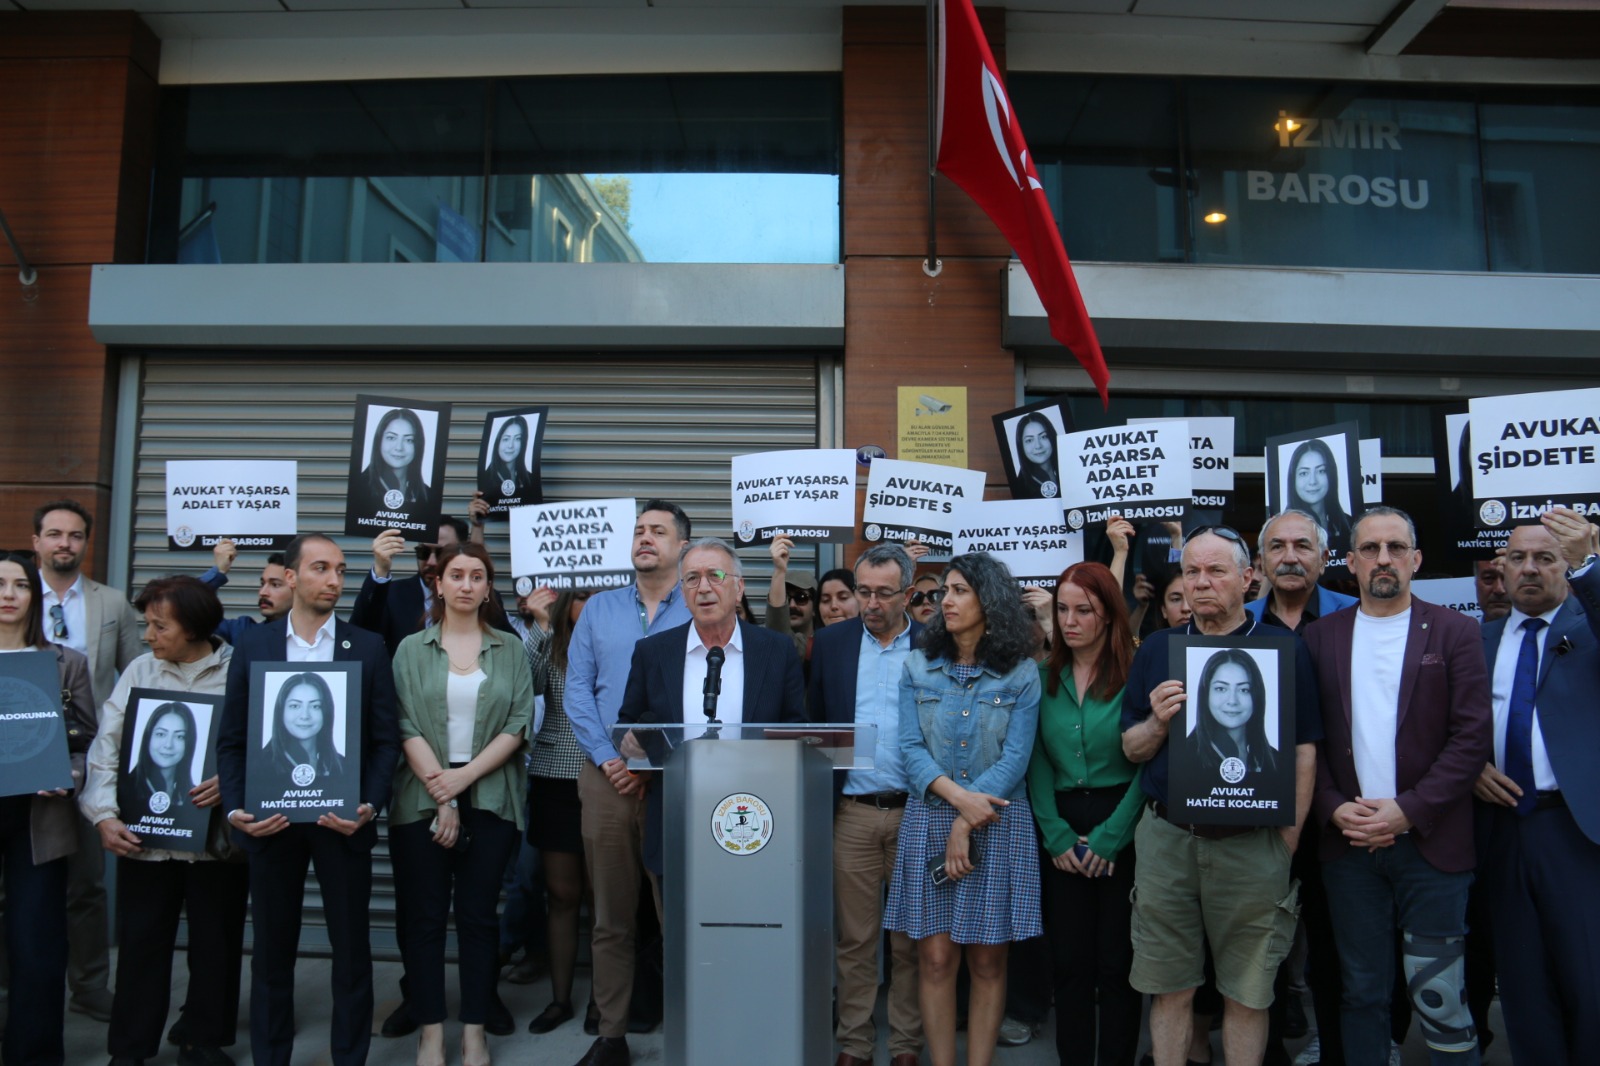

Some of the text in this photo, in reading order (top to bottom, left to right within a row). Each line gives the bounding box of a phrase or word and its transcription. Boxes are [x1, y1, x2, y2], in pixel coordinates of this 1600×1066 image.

[1278, 110, 1402, 150] İZMİR
[1247, 170, 1429, 210] BAROSU
[1500, 416, 1600, 441] AVUKA
[1083, 430, 1158, 450] AVUKAT
[1079, 447, 1166, 468] YAŞARSA
[1192, 457, 1229, 470] SON
[1477, 446, 1595, 475] ŞİDDETE
[1086, 465, 1159, 484] ADALET
[736, 475, 849, 491] AVUKAT YAŞARSA
[885, 477, 964, 498] AVUKATA
[172, 485, 290, 497] AVUKAT YAŞARSA
[744, 489, 839, 504] ADALET YAŞAR
[1091, 482, 1154, 501] YAŞAR
[182, 500, 281, 511] ADALET YAŞAR
[498, 497, 521, 505] AVUKAT
[869, 490, 938, 512] ŞİDDETE
[1191, 496, 1226, 507] ROSU
[375, 510, 410, 520] AVUKAT
[537, 506, 608, 522] AVUKAT
[1124, 505, 1184, 519] BAROSU
[357, 517, 427, 531] HATİCE KOCAEFE
[531, 522, 614, 539] YAŞARSA
[786, 529, 830, 538] BAROSU
[958, 527, 1010, 539] AVUKAT
[1477, 530, 1513, 539] AVUKA
[232, 537, 273, 546] BAROSU
[538, 538, 608, 553] ADALET
[918, 533, 953, 548] BARO
[968, 539, 1068, 552] ADALET YAŞAR
[1457, 538, 1492, 548] HATİCE
[543, 554, 603, 570] YAŞAR
[535, 574, 631, 589] İZMİR BAROSU
[283, 789, 323, 798] AVUKAT
[1211, 787, 1255, 796] AVUKAT
[261, 798, 344, 808] HATİCE KOCAEFE
[735, 796, 767, 816] BAROSU
[1186, 797, 1278, 809] HATİCE KOCAEFE
[140, 815, 175, 826] AVUKAT
[152, 826, 193, 838] KOCAEFE
